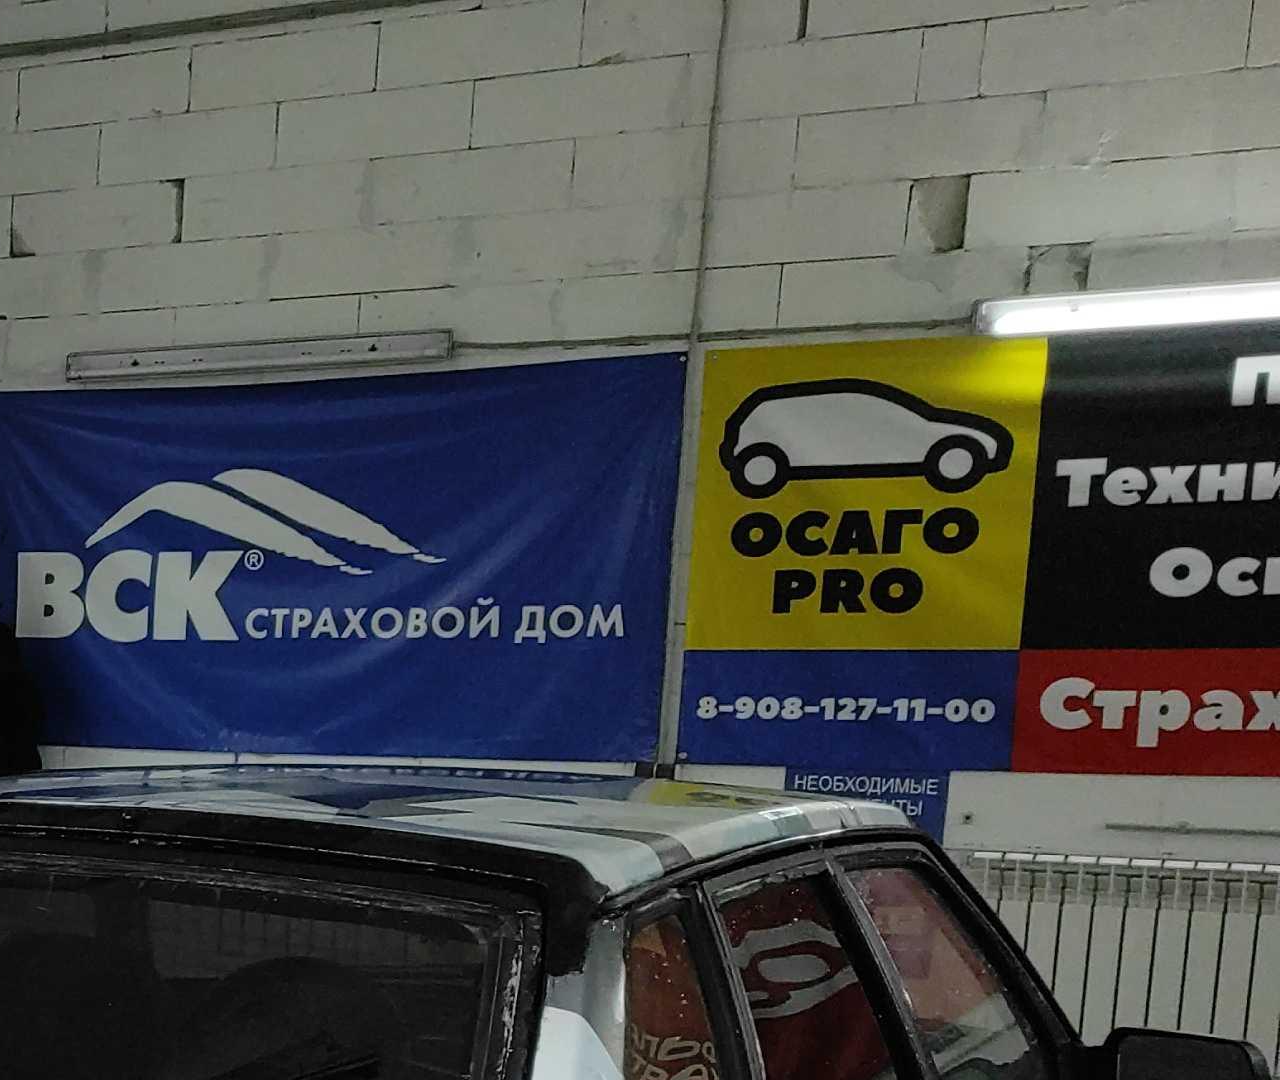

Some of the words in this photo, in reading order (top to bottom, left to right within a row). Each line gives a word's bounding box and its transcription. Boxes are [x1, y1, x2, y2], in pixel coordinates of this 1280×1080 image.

[731, 506, 980, 558] ОСАГО
[771, 567, 924, 614] PRO
[245, 597, 500, 640] СТРАХОВОЙ
[514, 604, 625, 644] ДОМ
[696, 697, 996, 723] 8-908-127-11-00
[794, 775, 939, 795] НЕОБХОДИМЫЕ
